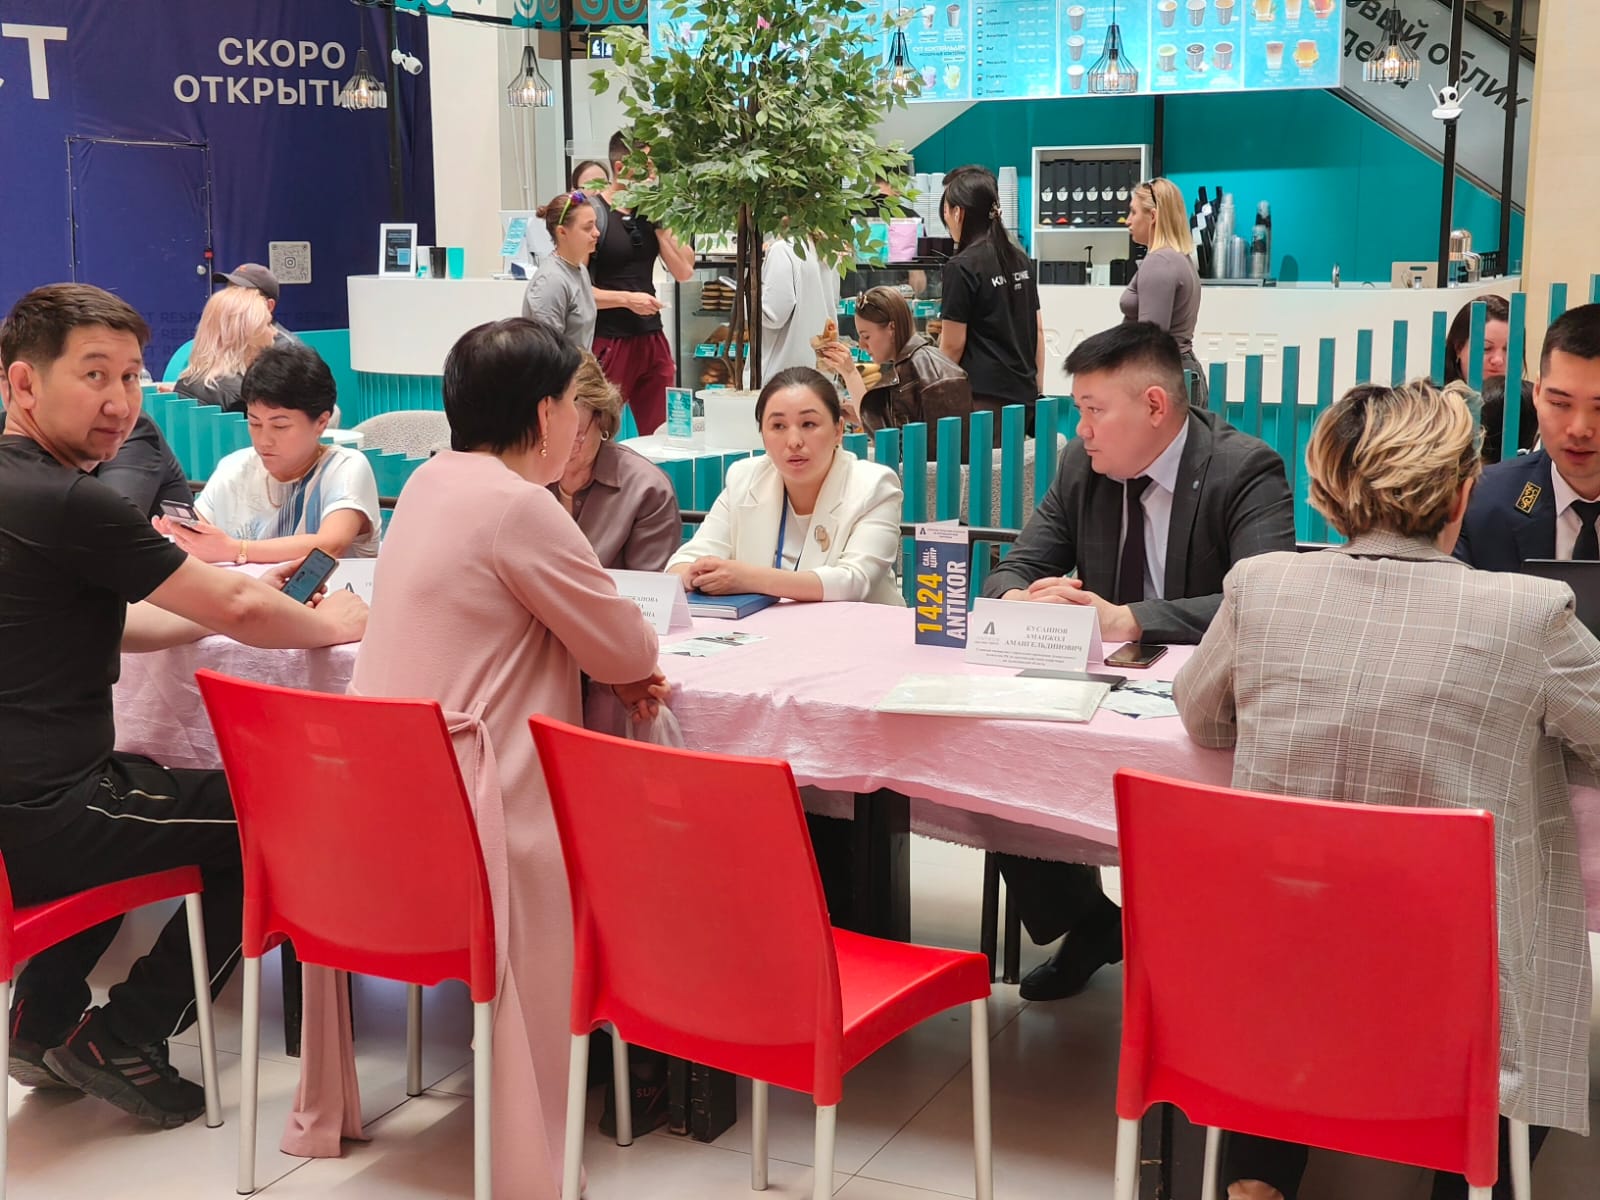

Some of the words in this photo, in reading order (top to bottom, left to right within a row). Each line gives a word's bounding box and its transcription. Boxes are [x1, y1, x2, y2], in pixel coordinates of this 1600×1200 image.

[0, 23, 68, 100] T
[217, 37, 346, 70] СКОРО
[1428, 43, 1529, 109] обли
[173, 74, 387, 108] ОТКРЫТИ
[917, 573, 943, 634] 1424
[946, 560, 967, 640] ANTIKOR
